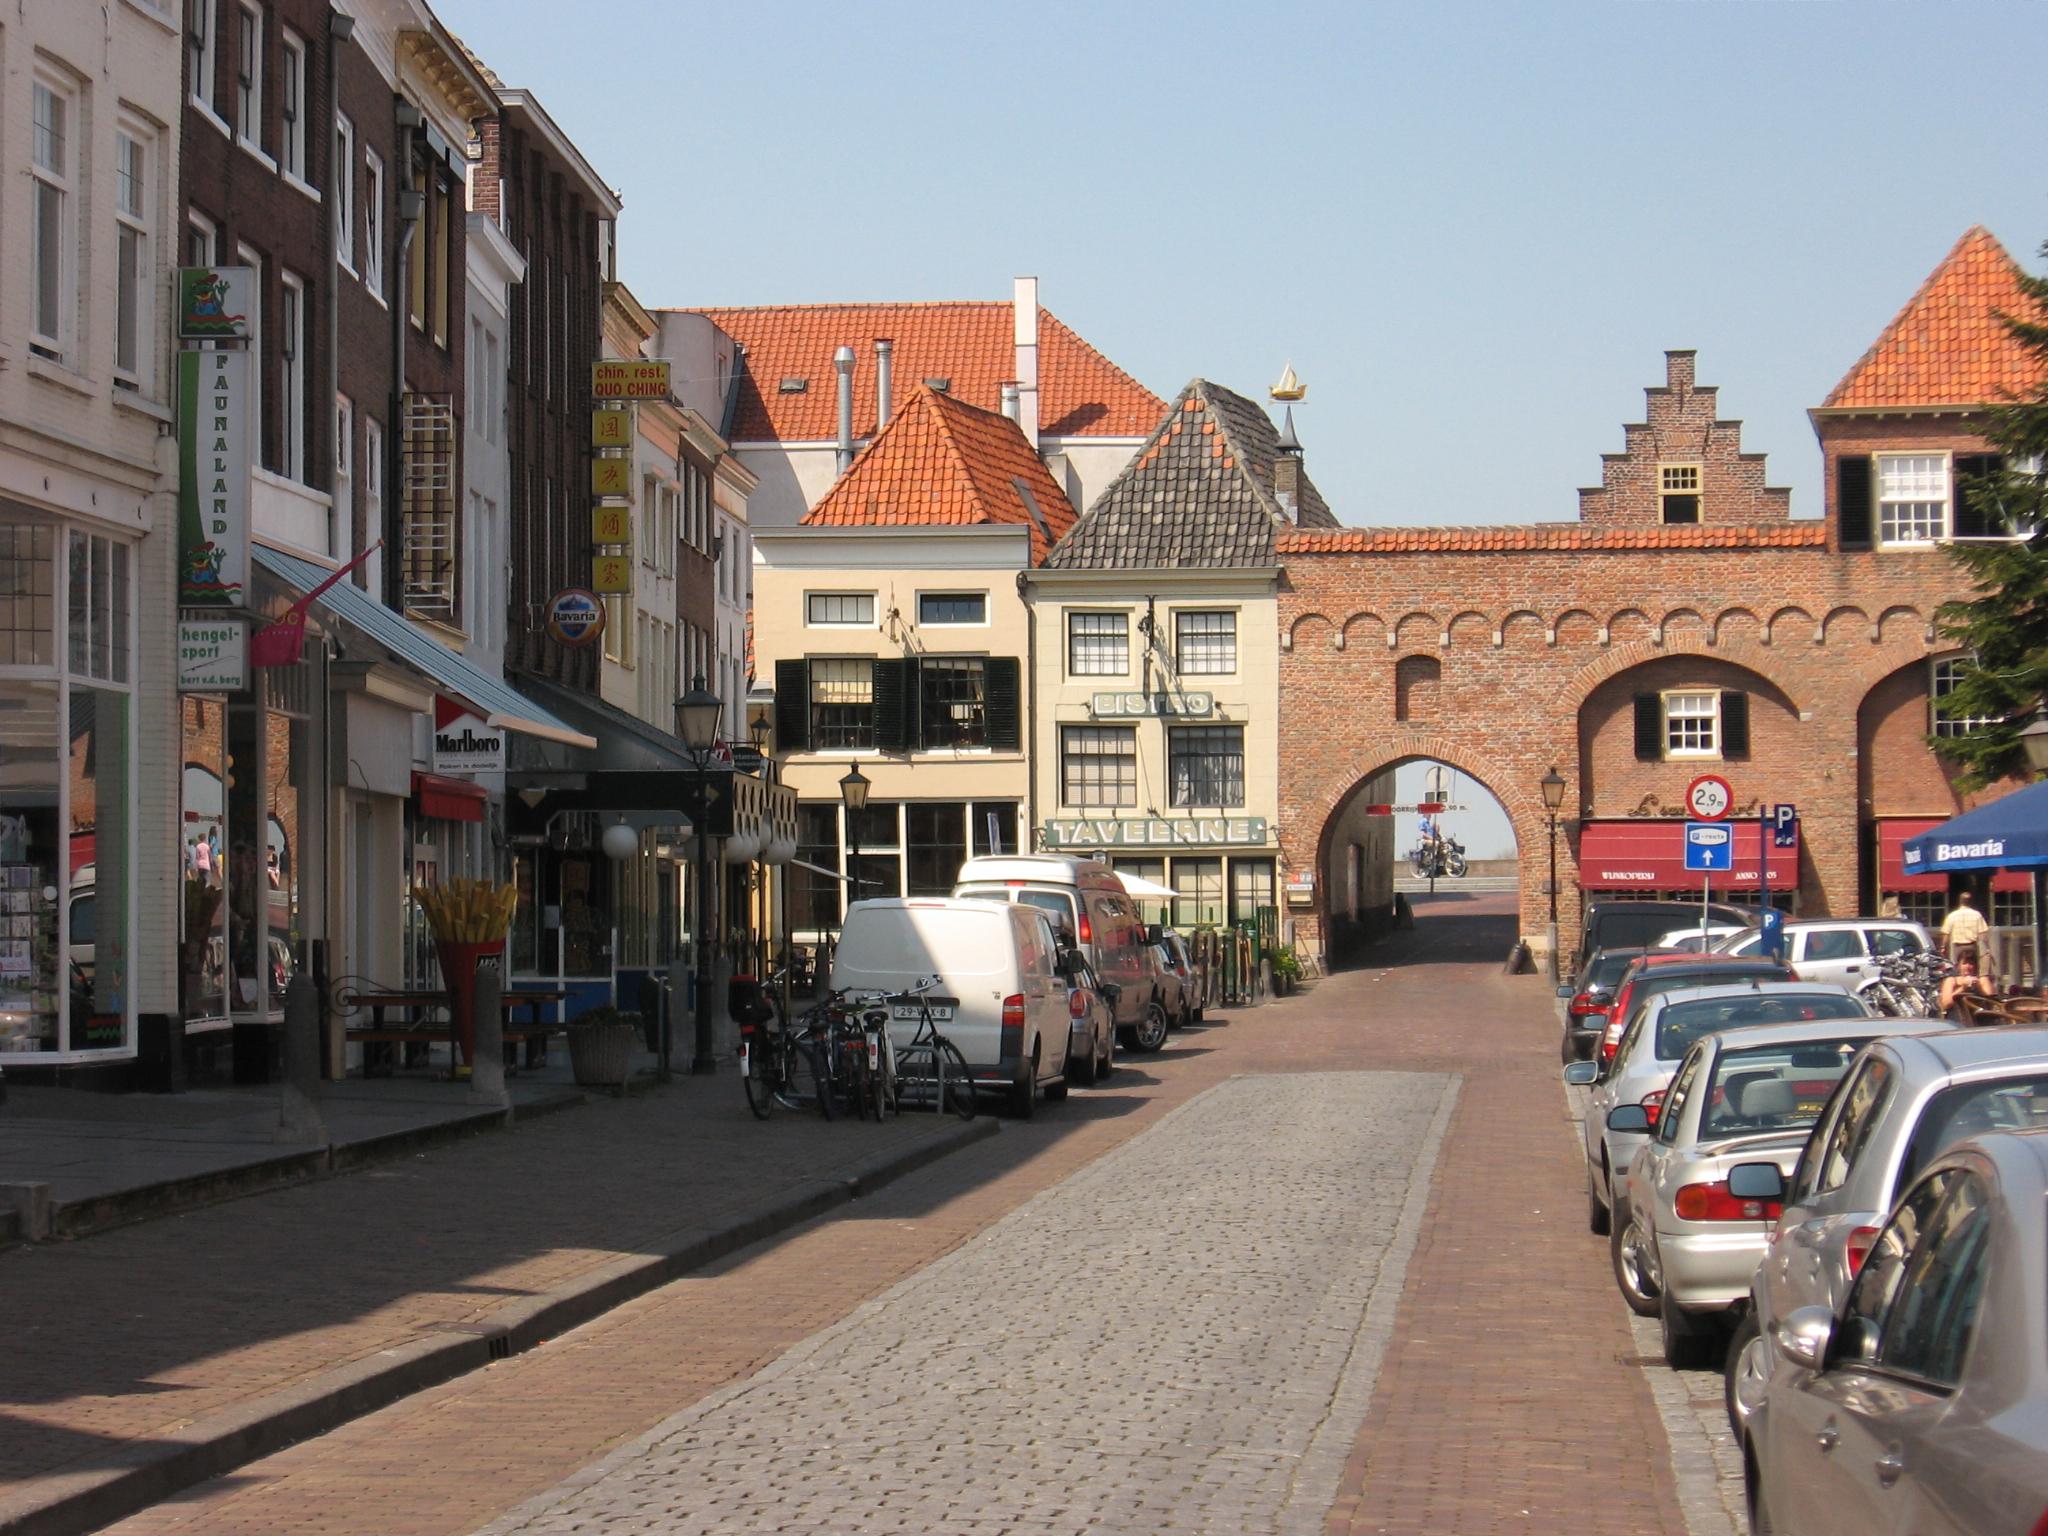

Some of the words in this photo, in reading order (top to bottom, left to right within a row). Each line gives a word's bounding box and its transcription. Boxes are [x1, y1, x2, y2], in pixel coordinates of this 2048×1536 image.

[597, 366, 628, 378] chin.
[635, 366, 665, 378] rest.
[595, 382, 622, 396] QUO
[628, 382, 667, 396] CHING
[213, 355, 229, 534] FAUNALAND
[553, 611, 596, 622] Bavaria
[182, 627, 239, 643] hengel-
[182, 646, 219, 660] sport
[1095, 694, 1209, 714] BISTRO
[436, 729, 500, 753] Marlboro
[1778, 807, 1793, 829] P
[1937, 839, 2003, 861] Bavaria
[1764, 913, 1774, 928] P
